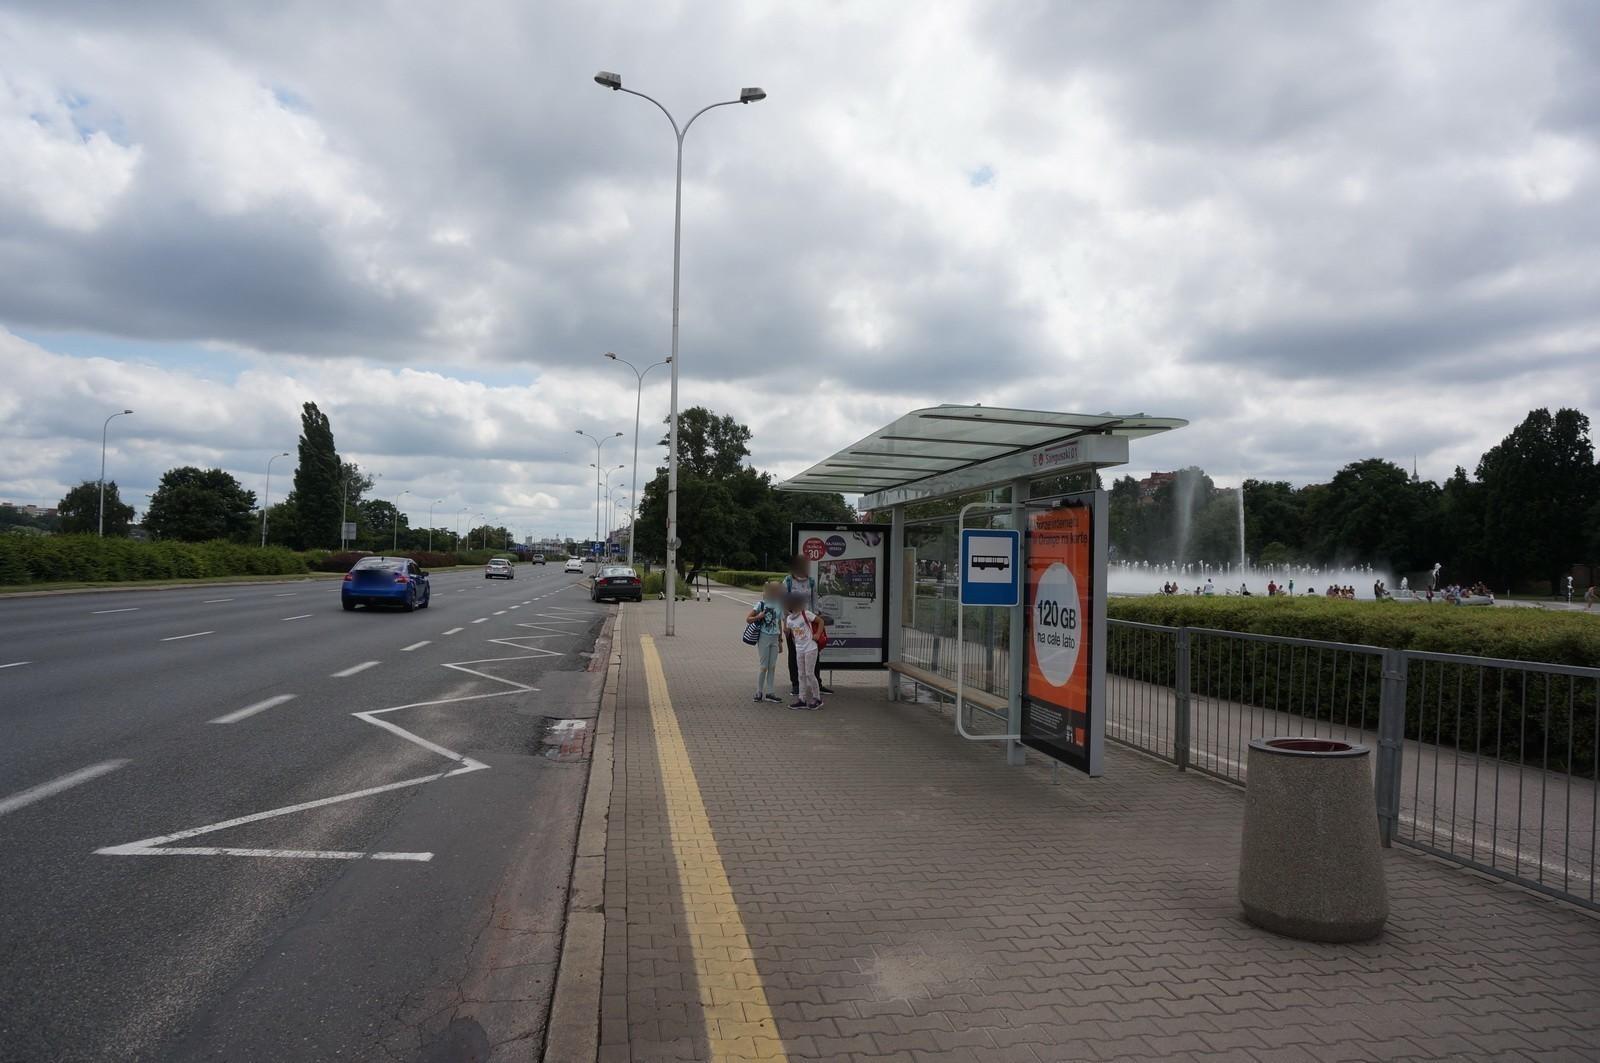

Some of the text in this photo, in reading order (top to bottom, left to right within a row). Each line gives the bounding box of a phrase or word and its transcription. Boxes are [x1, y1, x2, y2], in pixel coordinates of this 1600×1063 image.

[808, 549, 819, 559] 30
[1038, 599, 1077, 630] 120 GB
[1037, 632, 1046, 643] na
[1062, 633, 1075, 649] lato
